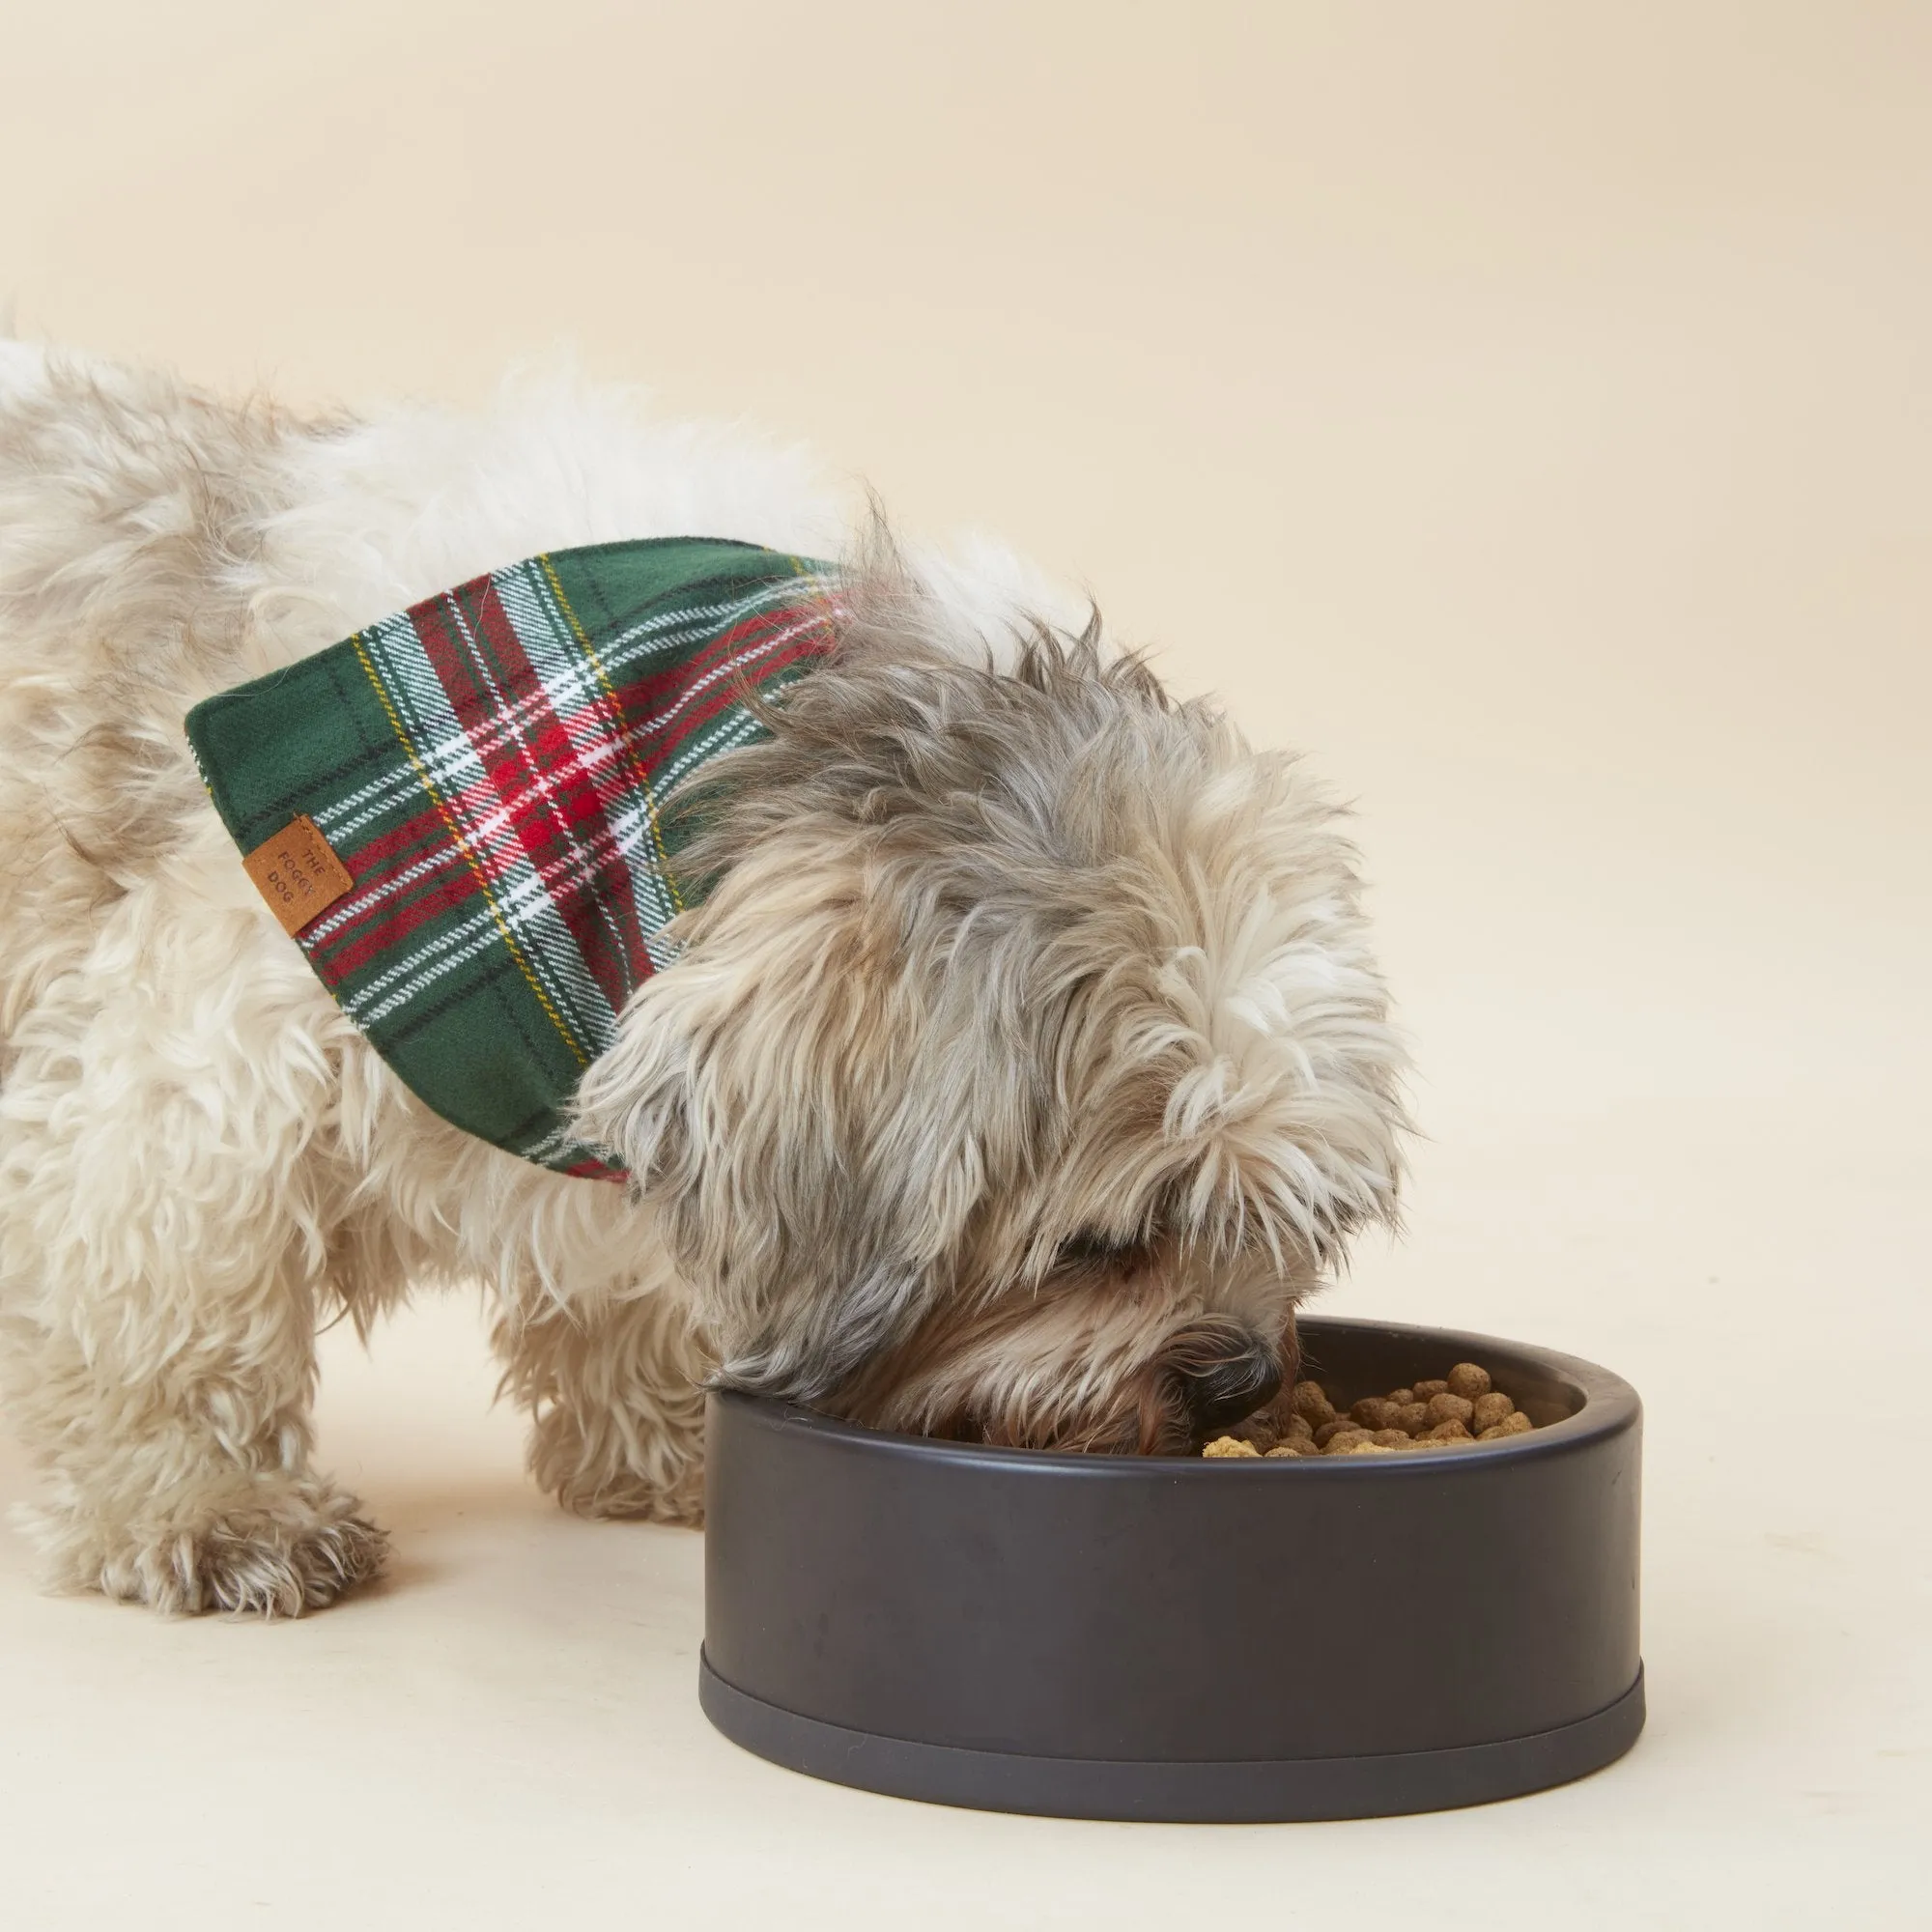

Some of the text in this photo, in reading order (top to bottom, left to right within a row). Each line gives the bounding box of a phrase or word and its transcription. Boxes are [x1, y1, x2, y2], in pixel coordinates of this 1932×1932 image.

[278, 851, 315, 896] FOGGY
[301, 849, 326, 876] THE
[268, 870, 294, 902] DOG
